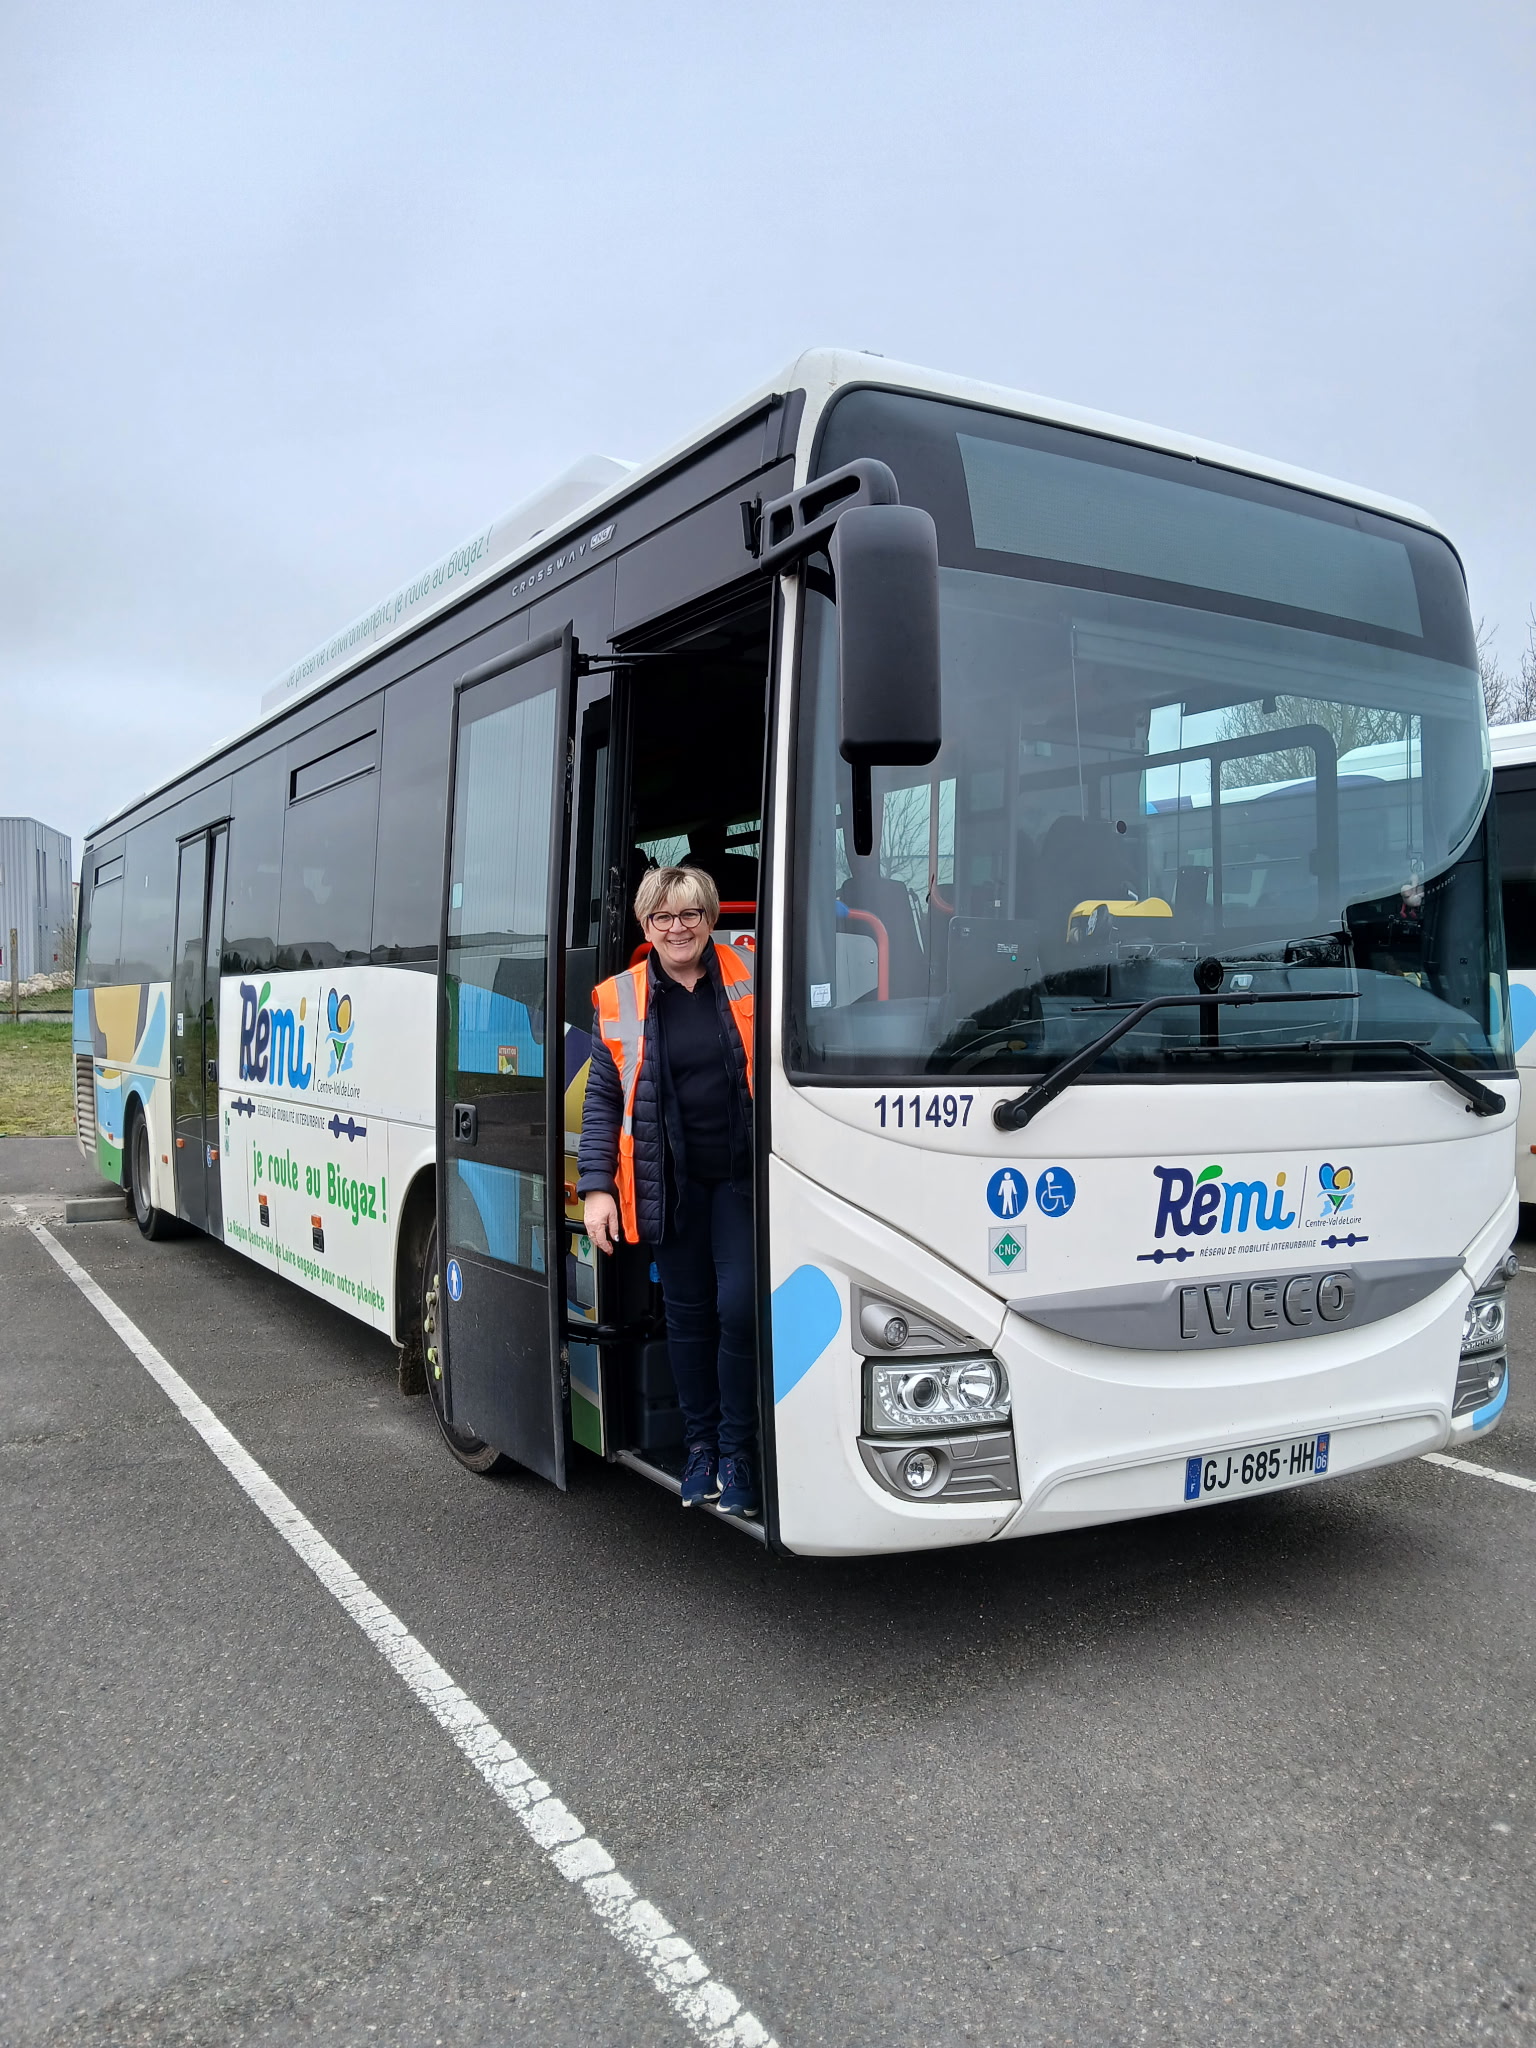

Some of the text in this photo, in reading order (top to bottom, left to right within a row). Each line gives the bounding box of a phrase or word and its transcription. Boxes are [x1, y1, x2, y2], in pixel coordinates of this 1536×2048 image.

[405, 570, 431, 608] roule
[432, 563, 446, 589] au
[448, 536, 484, 579] Biogaz
[511, 543, 587, 597] CROSSWAY
[239, 980, 312, 1091] Rémi
[874, 1094, 974, 1128] 111497
[253, 1139, 263, 1187] je
[268, 1148, 299, 1191] roule
[306, 1165, 321, 1199] au
[327, 1161, 377, 1226] Biogaz
[1153, 1164, 1296, 1239] Rémi
[227, 1216, 232, 1233] La
[232, 1219, 248, 1242] Région
[282, 1243, 296, 1266] Loire
[321, 1267, 335, 1287] pour
[337, 1274, 356, 1297] notre
[357, 1280, 385, 1312] planète
[998, 1243, 1017, 1256] CNG
[1199, 1239, 1317, 1257] RÉSEAU DE MOBILITÉ INTERURBAINE
[1179, 1272, 1356, 1340] IVECO
[1190, 1482, 1196, 1493] F
[1203, 1440, 1315, 1492] GJ-685-HH
[1316, 1454, 1327, 1470] 06
